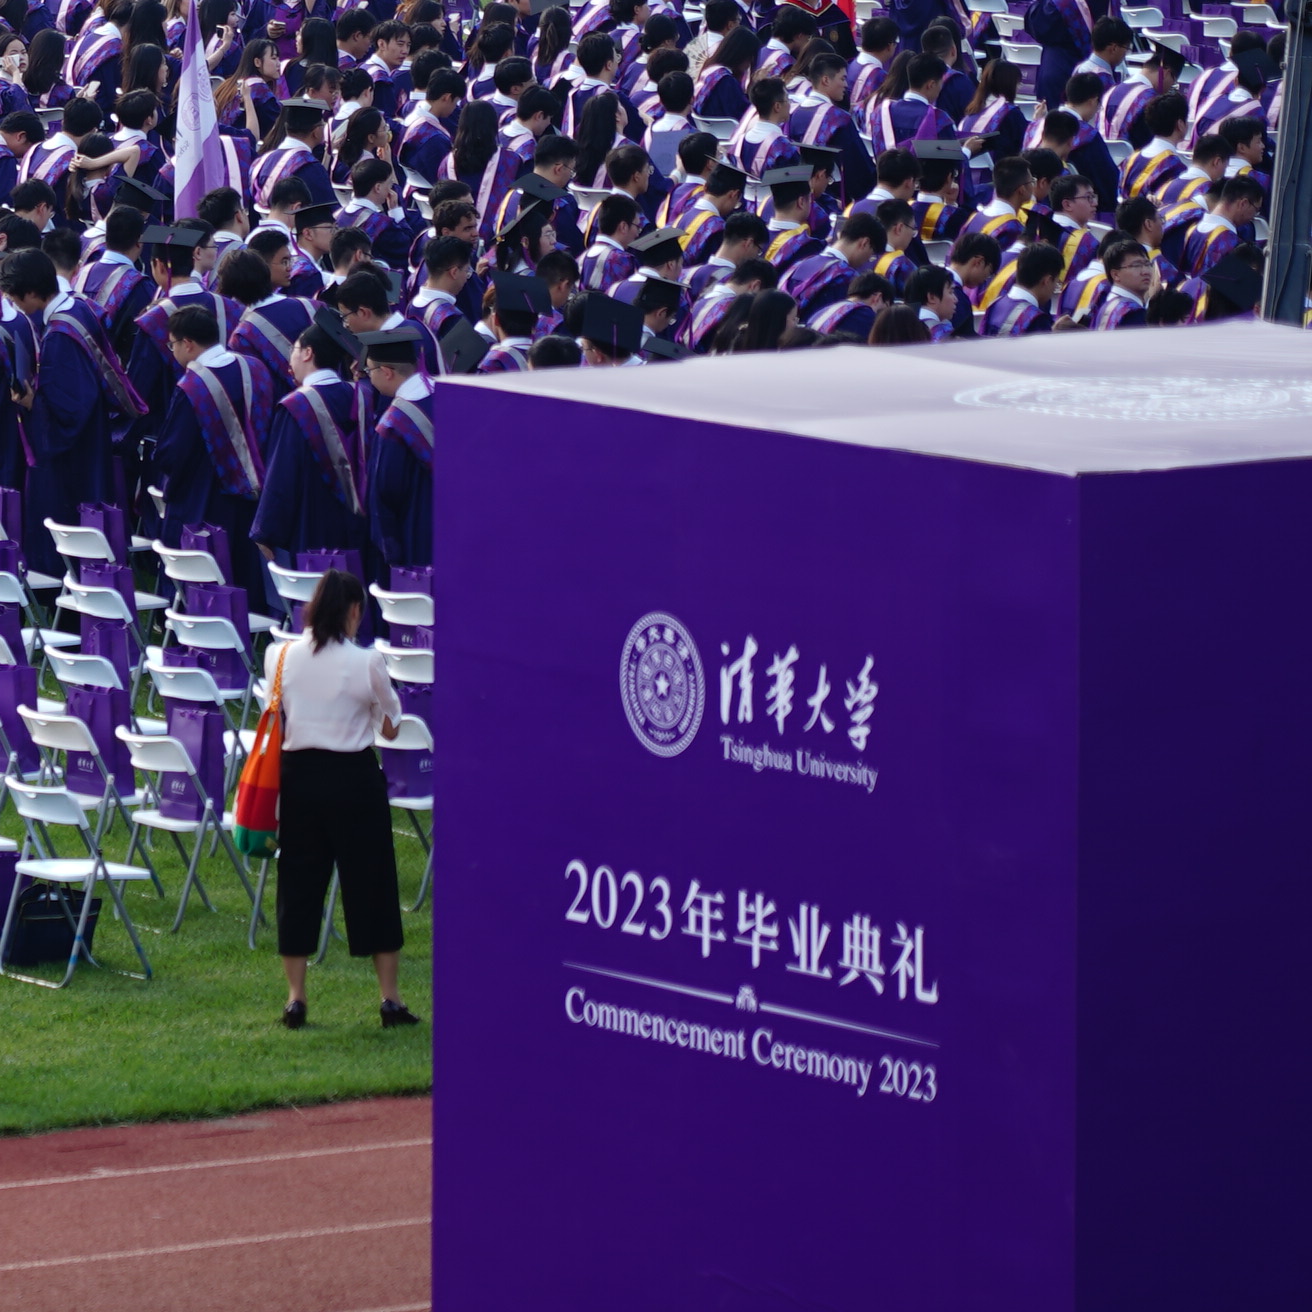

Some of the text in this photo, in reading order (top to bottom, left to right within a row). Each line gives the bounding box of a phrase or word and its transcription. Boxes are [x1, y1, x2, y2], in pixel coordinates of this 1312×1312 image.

[720, 735, 879, 794] Tsinghua University
[564, 858, 939, 1005] 2023年毕业典礼
[564, 986, 938, 1103] Commencement Ceremony 2023
